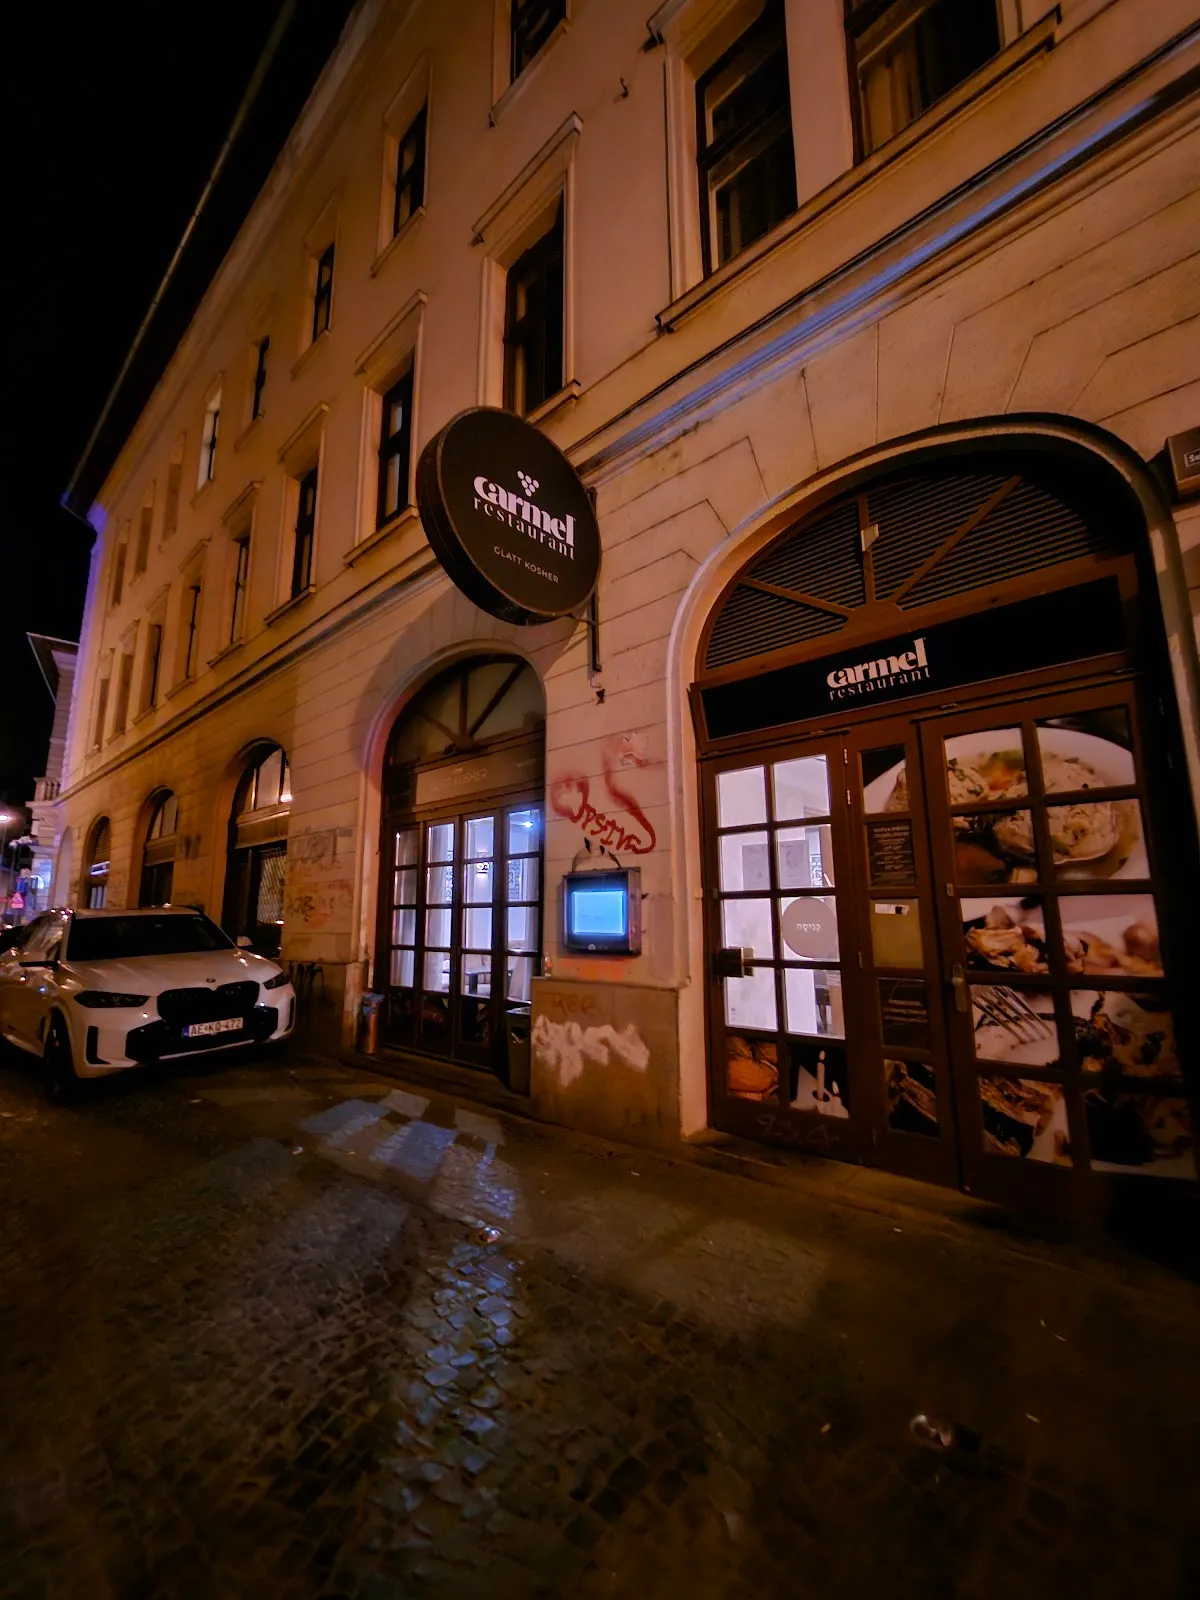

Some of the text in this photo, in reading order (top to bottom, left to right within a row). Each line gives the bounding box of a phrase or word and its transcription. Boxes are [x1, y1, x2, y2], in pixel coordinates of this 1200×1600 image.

[474, 476, 575, 547] carmel
[474, 497, 575, 560] restaurant
[494, 546, 560, 584] GLATT KOSHER
[826, 637, 929, 689] carmel
[829, 666, 931, 700] restaurant
